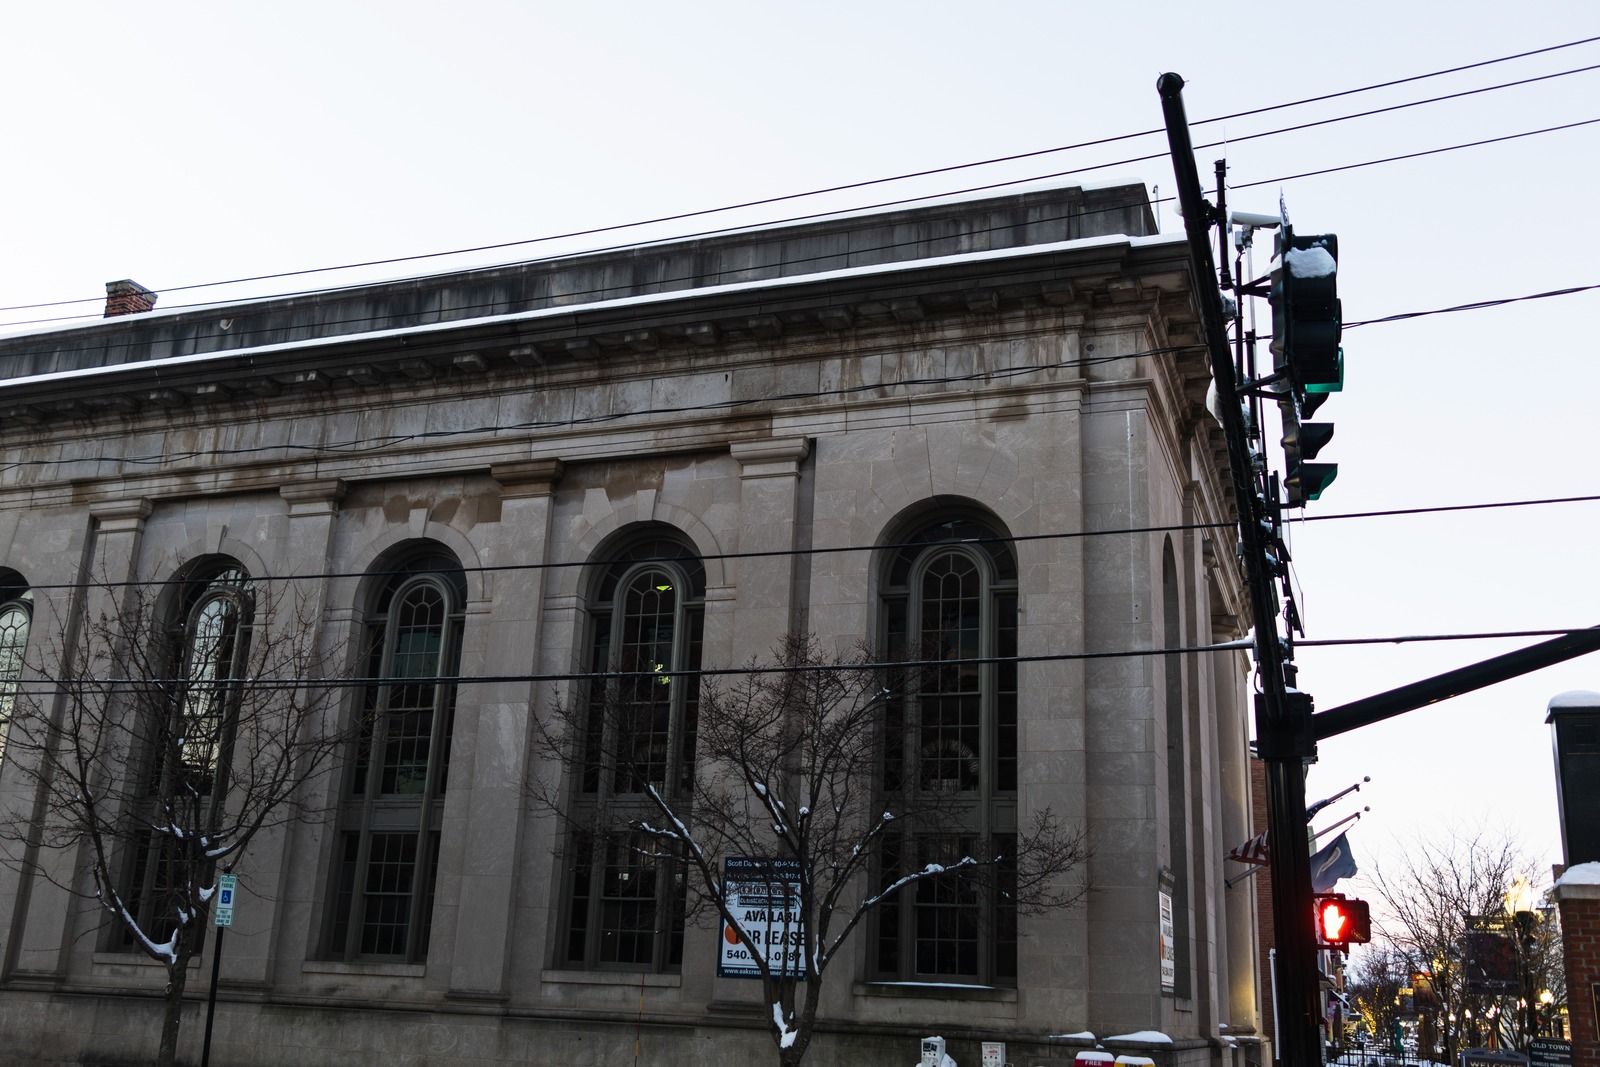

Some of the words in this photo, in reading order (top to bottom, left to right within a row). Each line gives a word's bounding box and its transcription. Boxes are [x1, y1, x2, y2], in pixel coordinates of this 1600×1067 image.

[727, 859, 742, 867] Scott
[744, 910, 804, 923] AVALABL
[1548, 1043, 1571, 1051] TOWN
